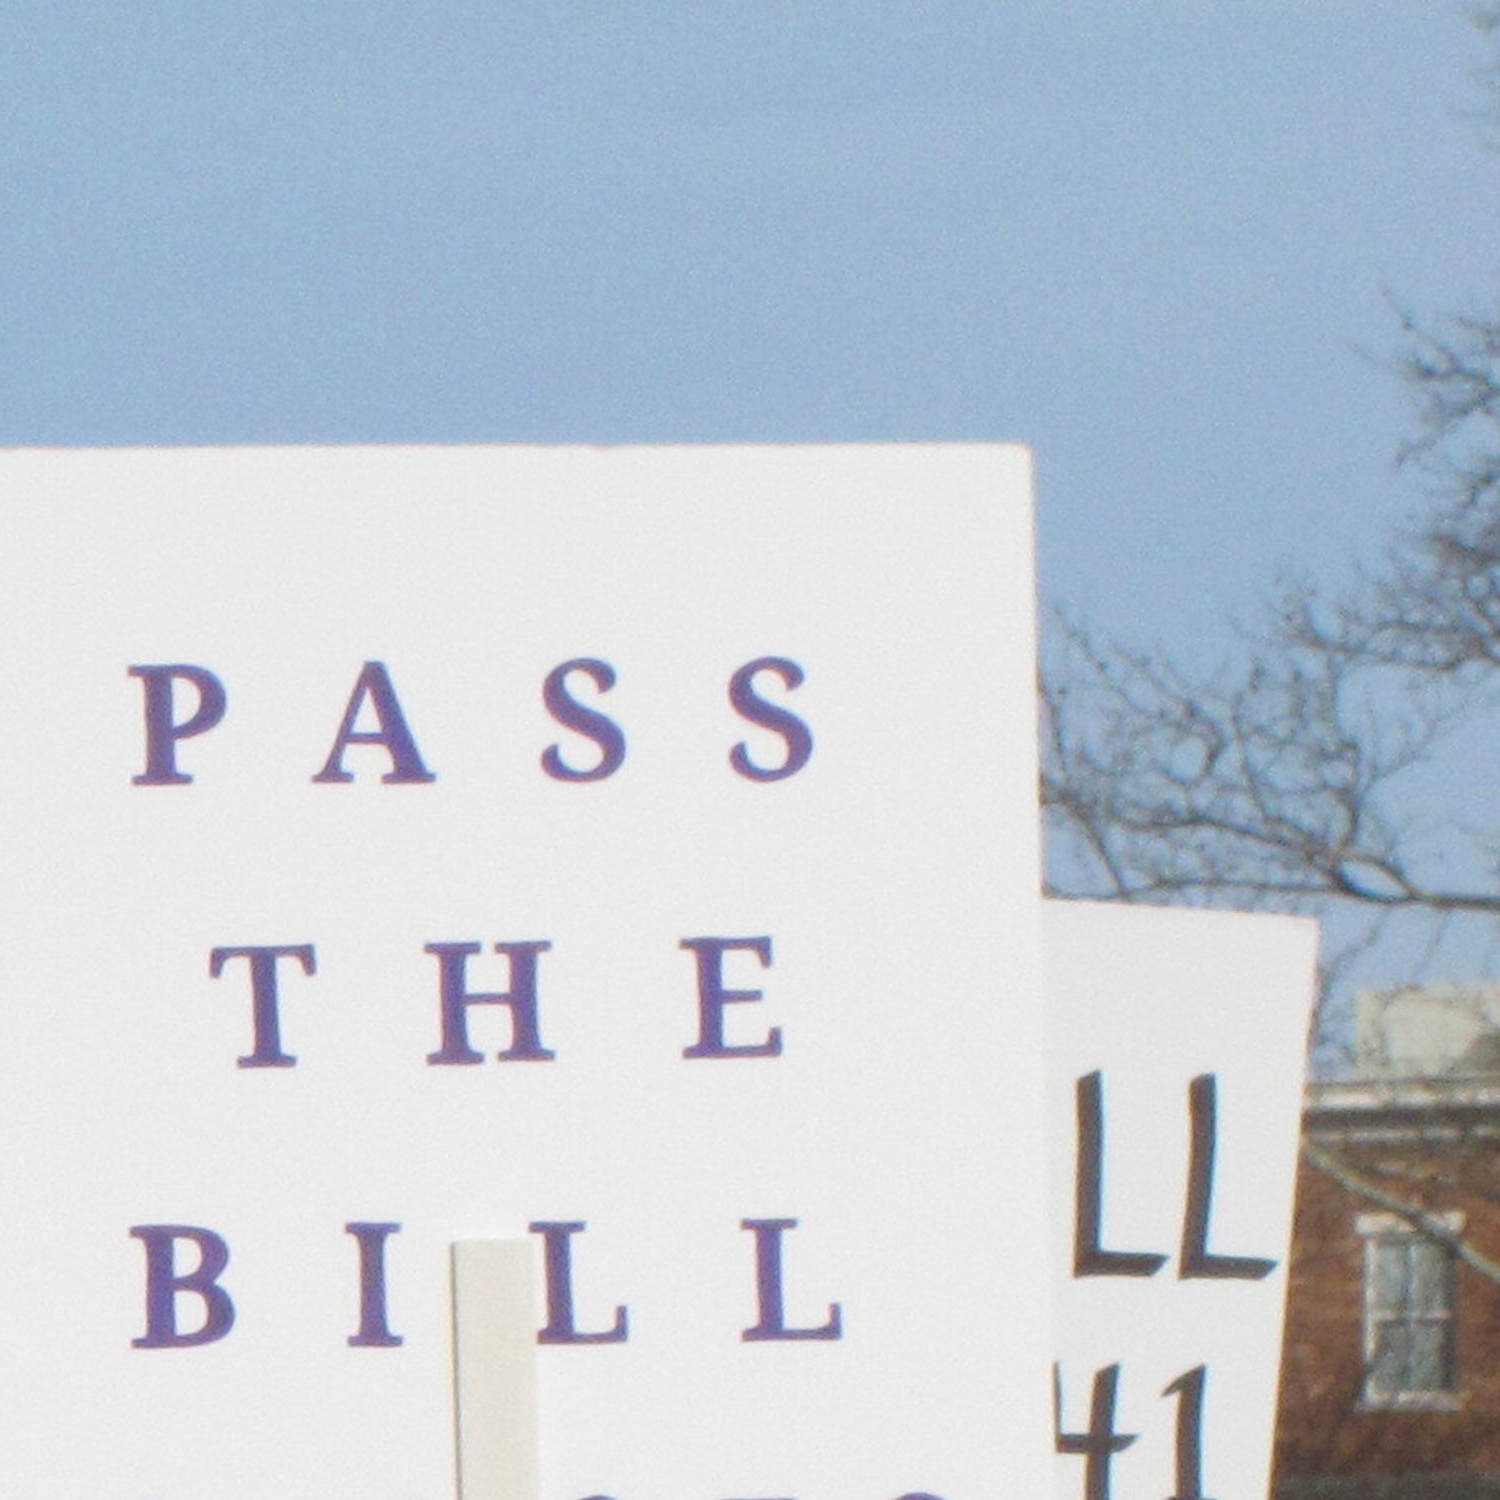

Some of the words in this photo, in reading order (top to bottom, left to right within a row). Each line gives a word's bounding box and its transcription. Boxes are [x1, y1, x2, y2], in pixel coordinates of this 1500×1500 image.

[127, 655, 815, 787] PASS
[208, 936, 784, 1068] THE
[1073, 1069, 1278, 1279] LL
[127, 1219, 843, 1348] BILL
